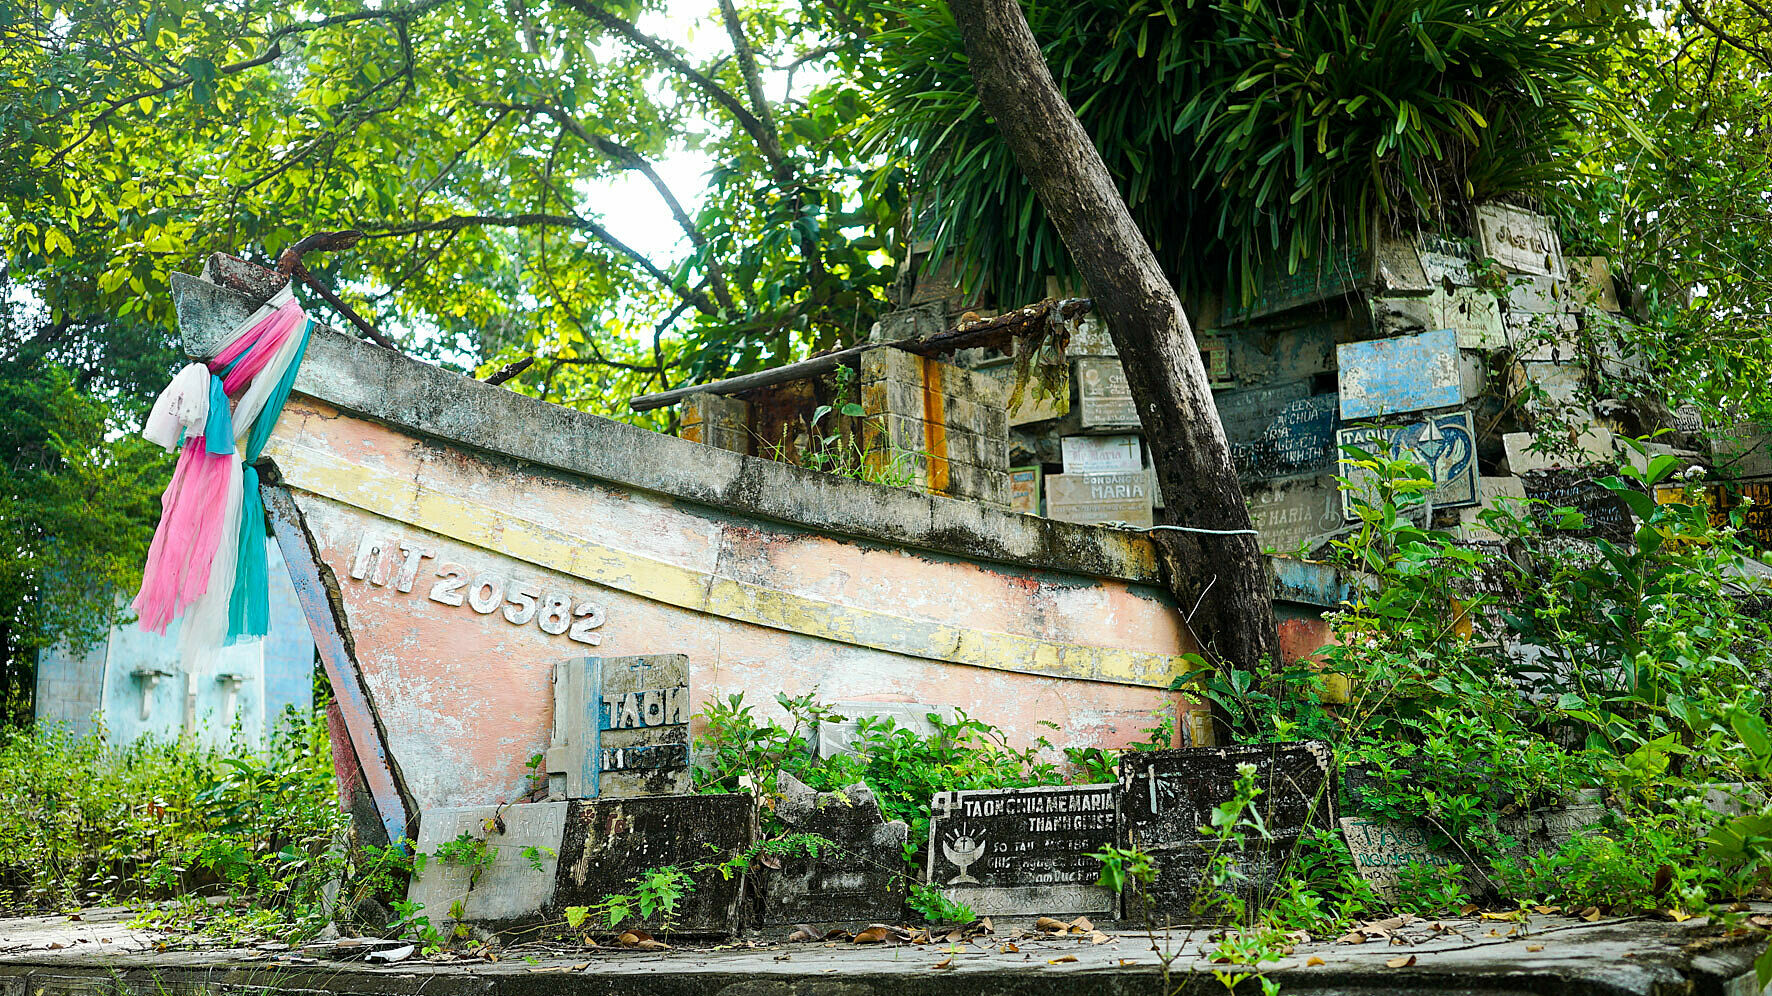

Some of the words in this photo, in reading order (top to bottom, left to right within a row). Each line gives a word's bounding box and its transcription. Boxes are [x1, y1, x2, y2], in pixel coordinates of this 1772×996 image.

[1091, 485, 1143, 499] MARIA
[428, 562, 607, 647] 20582
[1069, 792, 1115, 812] MARIA
